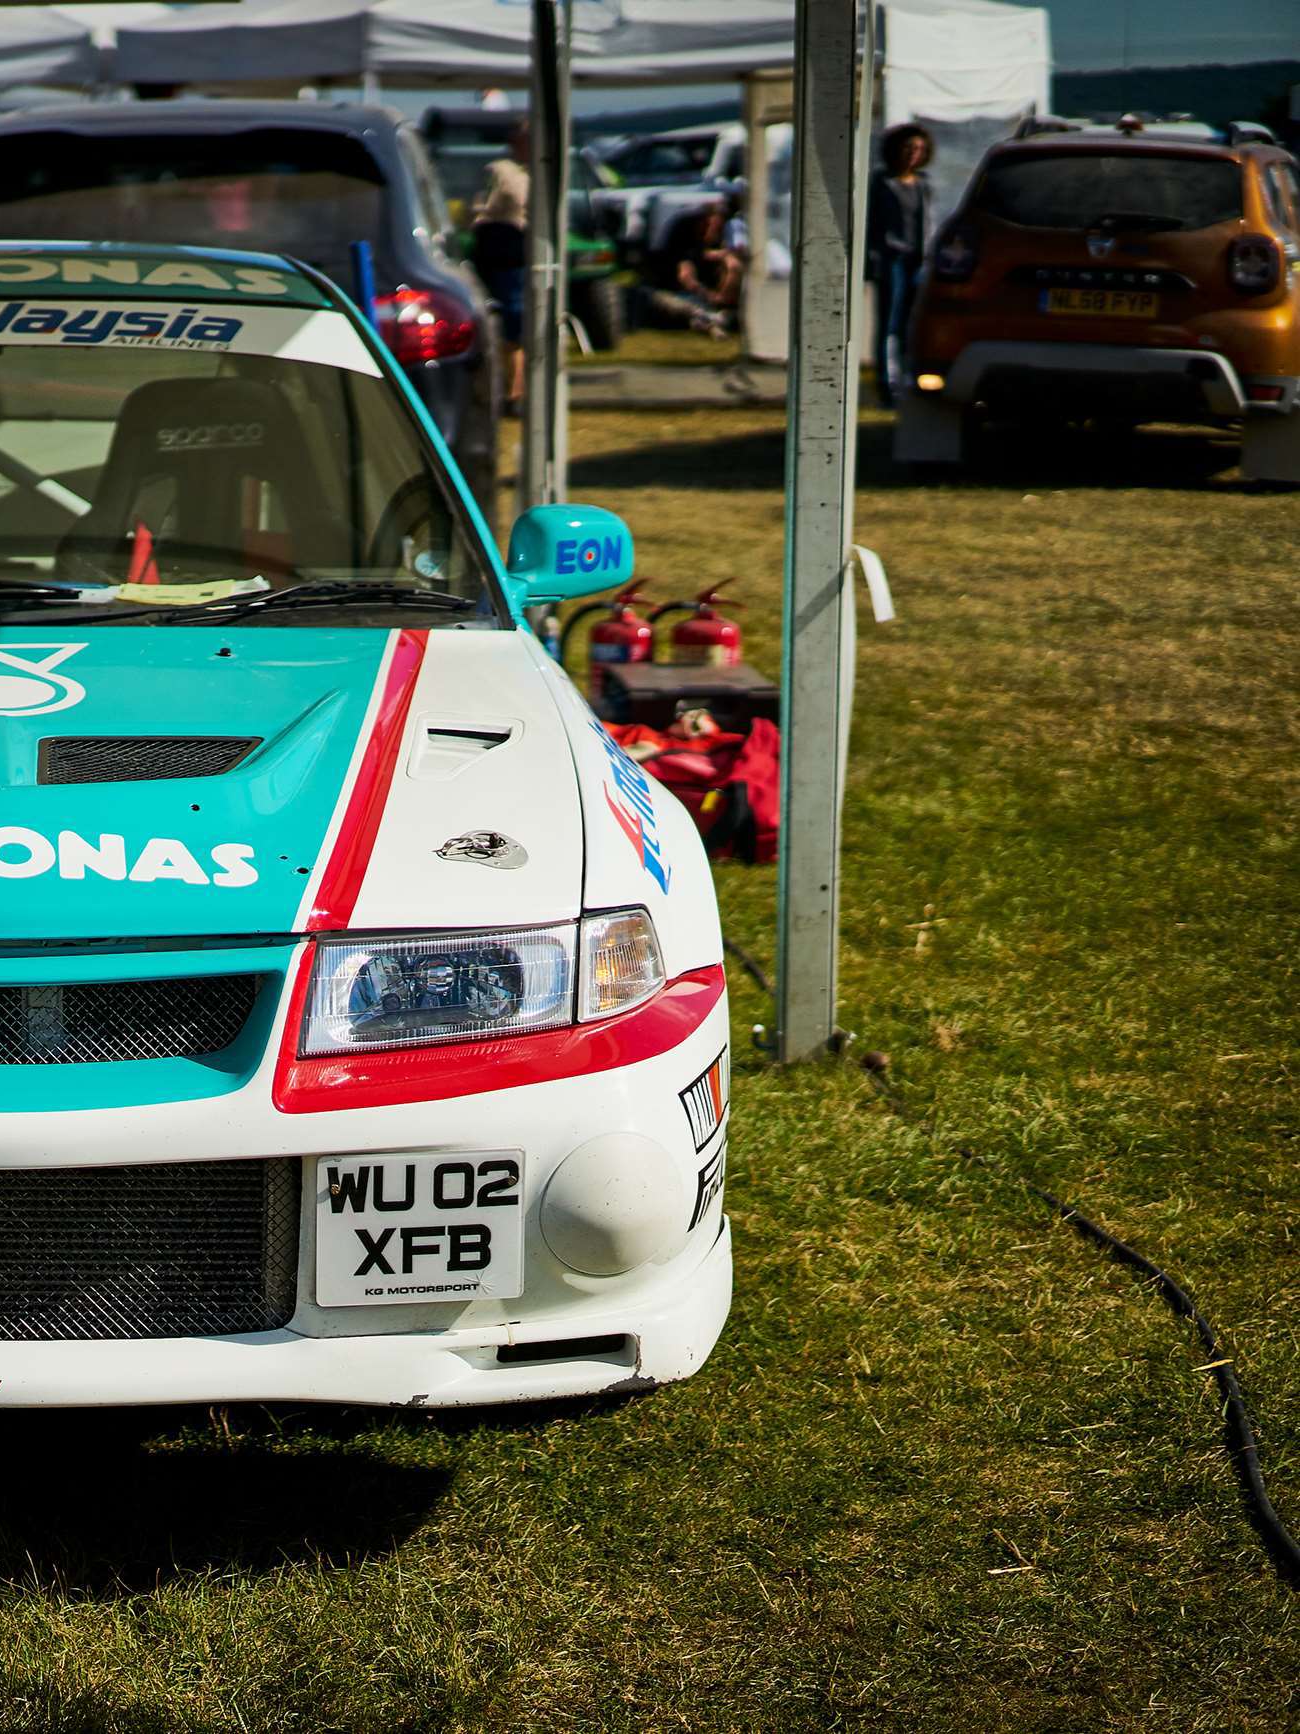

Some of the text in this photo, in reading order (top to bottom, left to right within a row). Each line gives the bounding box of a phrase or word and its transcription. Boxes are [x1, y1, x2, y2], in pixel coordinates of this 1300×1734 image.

[156, 421, 265, 447] sparco
[555, 535, 622, 575] EON
[327, 1159, 520, 1214] WU 02
[353, 1223, 492, 1276] XFB
[387, 1283, 480, 1295] MOTORSPORT
